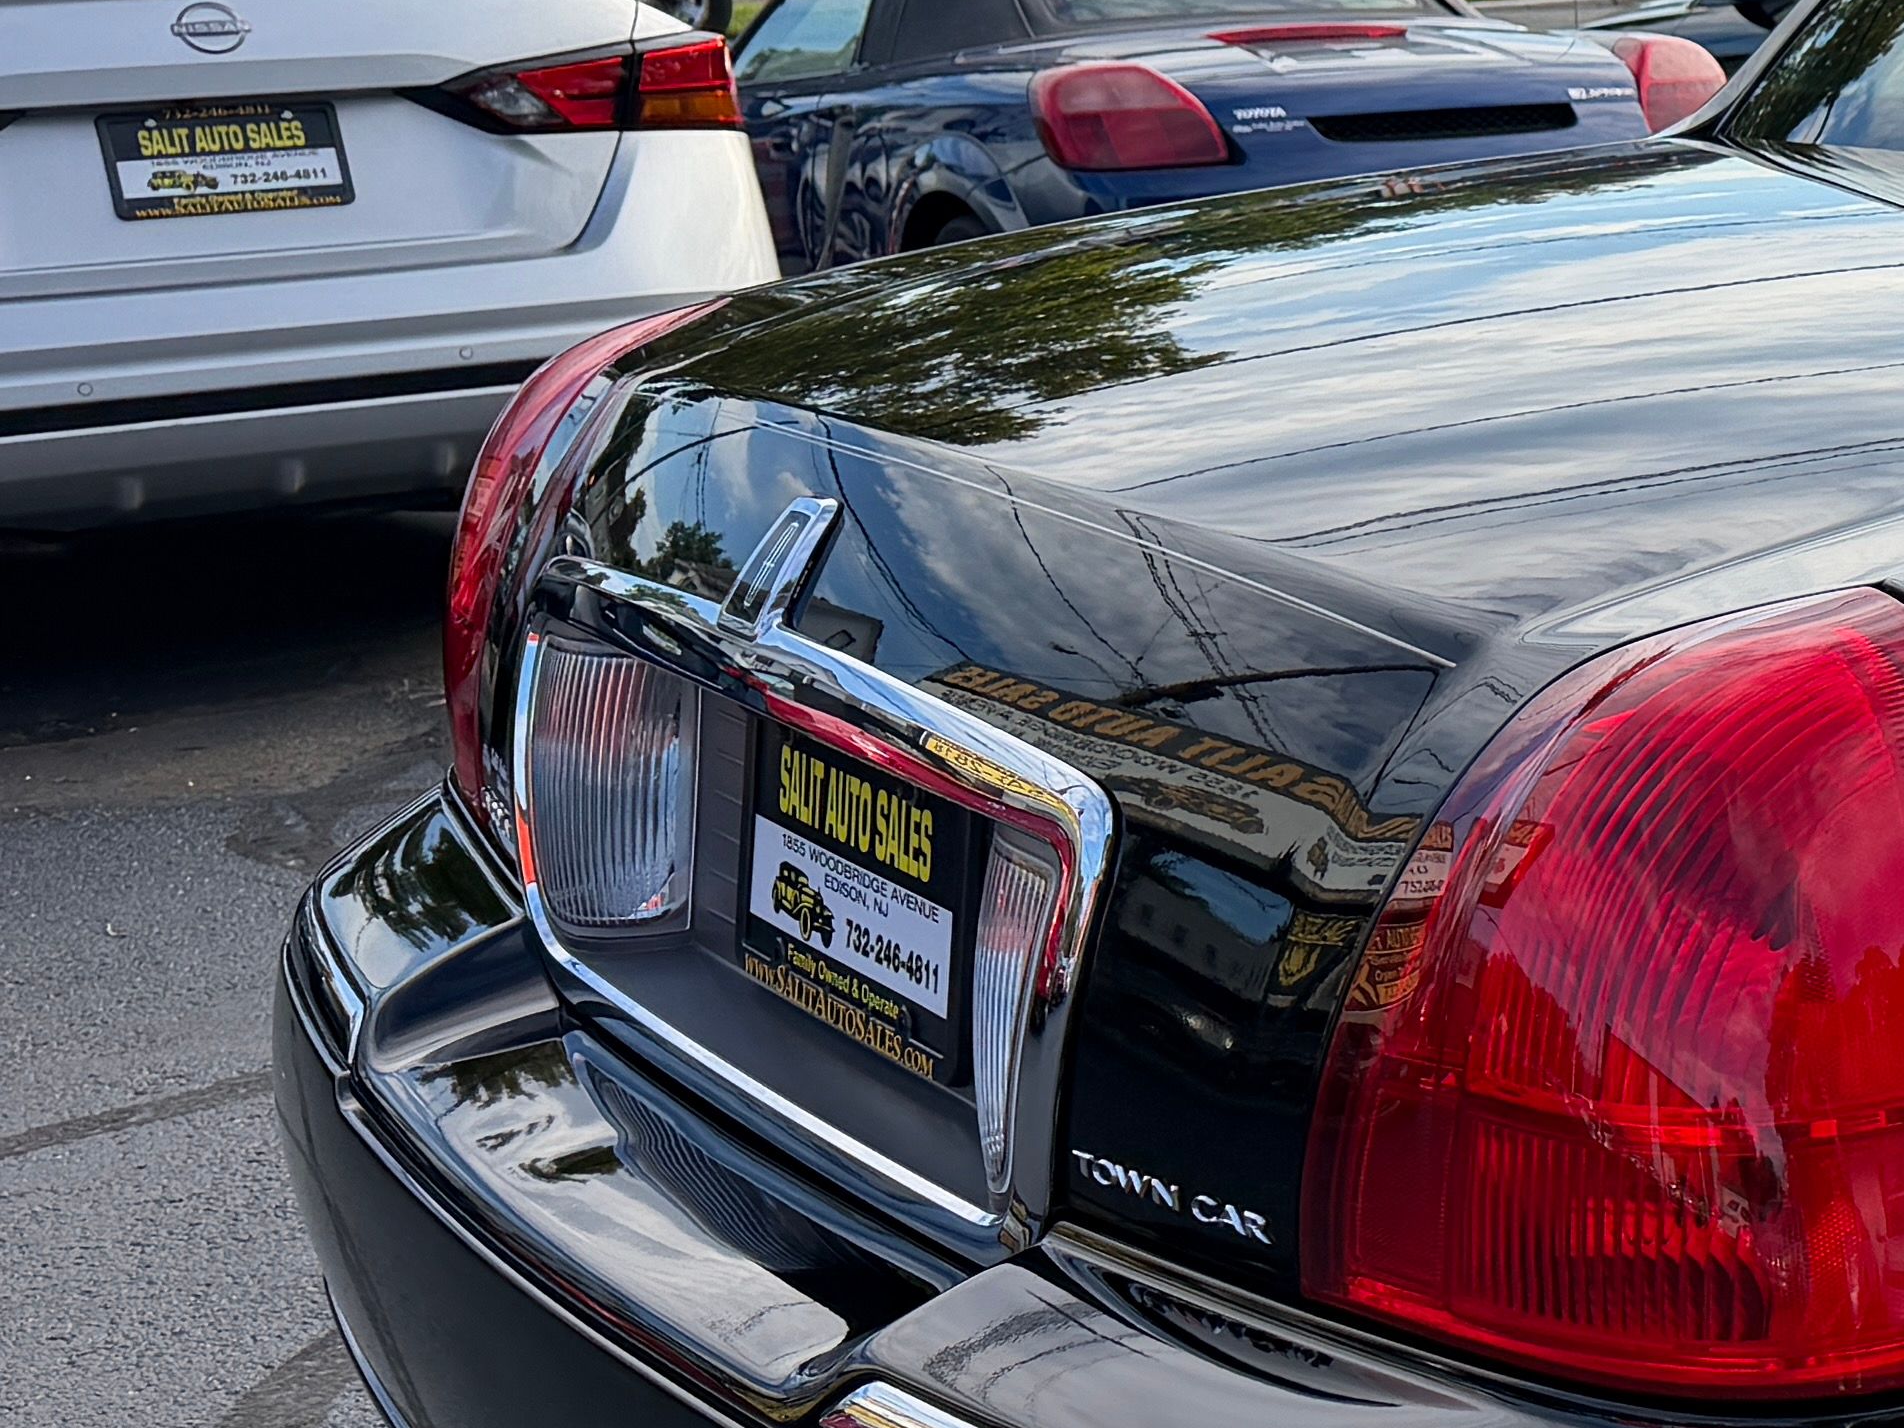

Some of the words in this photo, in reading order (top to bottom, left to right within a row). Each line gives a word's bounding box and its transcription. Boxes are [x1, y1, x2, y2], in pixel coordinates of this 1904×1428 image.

[172, 21, 250, 36] NISSAN
[137, 128, 191, 157] SALIT
[196, 124, 244, 153] AUTO
[249, 121, 306, 149] SALES
[231, 168, 328, 185] 732-246-4811
[779, 743, 824, 829] SALIT
[825, 767, 872, 853] AUTO
[875, 789, 933, 883] SALES
[782, 833, 806, 857] 1855
[808, 845, 888, 896] WOODBRIDGE
[891, 889, 940, 923] AVENUE
[824, 874, 870, 911] EDISON,
[873, 899, 889, 918] NJ
[787, 943, 817, 977] Family
[818, 960, 850, 993] Owned
[851, 978, 860, 1000] &
[862, 984, 899, 1019] Operate
[846, 918, 939, 994] 732-246-4811
[1072, 1149, 1180, 1212] TOWN
[1190, 1195, 1274, 1245] CAR
